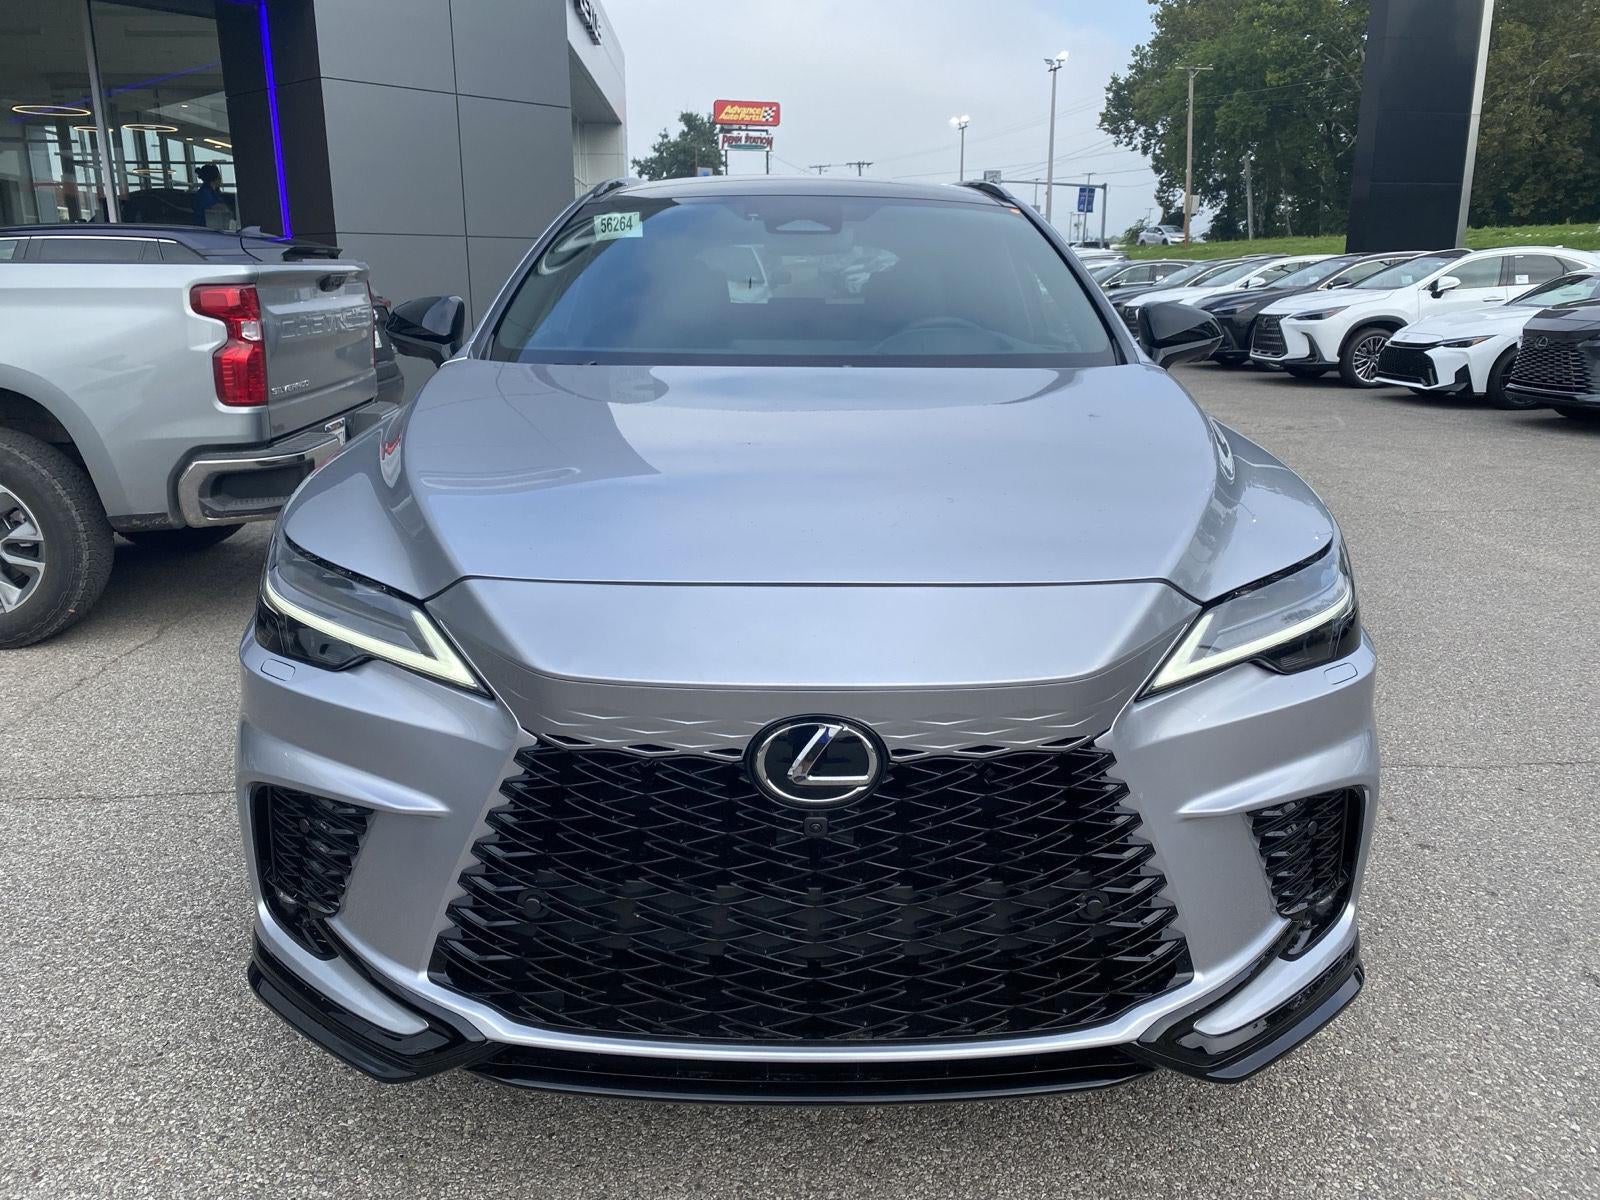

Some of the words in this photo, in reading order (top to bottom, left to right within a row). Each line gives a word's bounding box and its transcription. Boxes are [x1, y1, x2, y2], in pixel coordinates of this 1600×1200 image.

[724, 105, 762, 115] Advance
[739, 113, 761, 121] Parts
[601, 216, 632, 233] 56264
